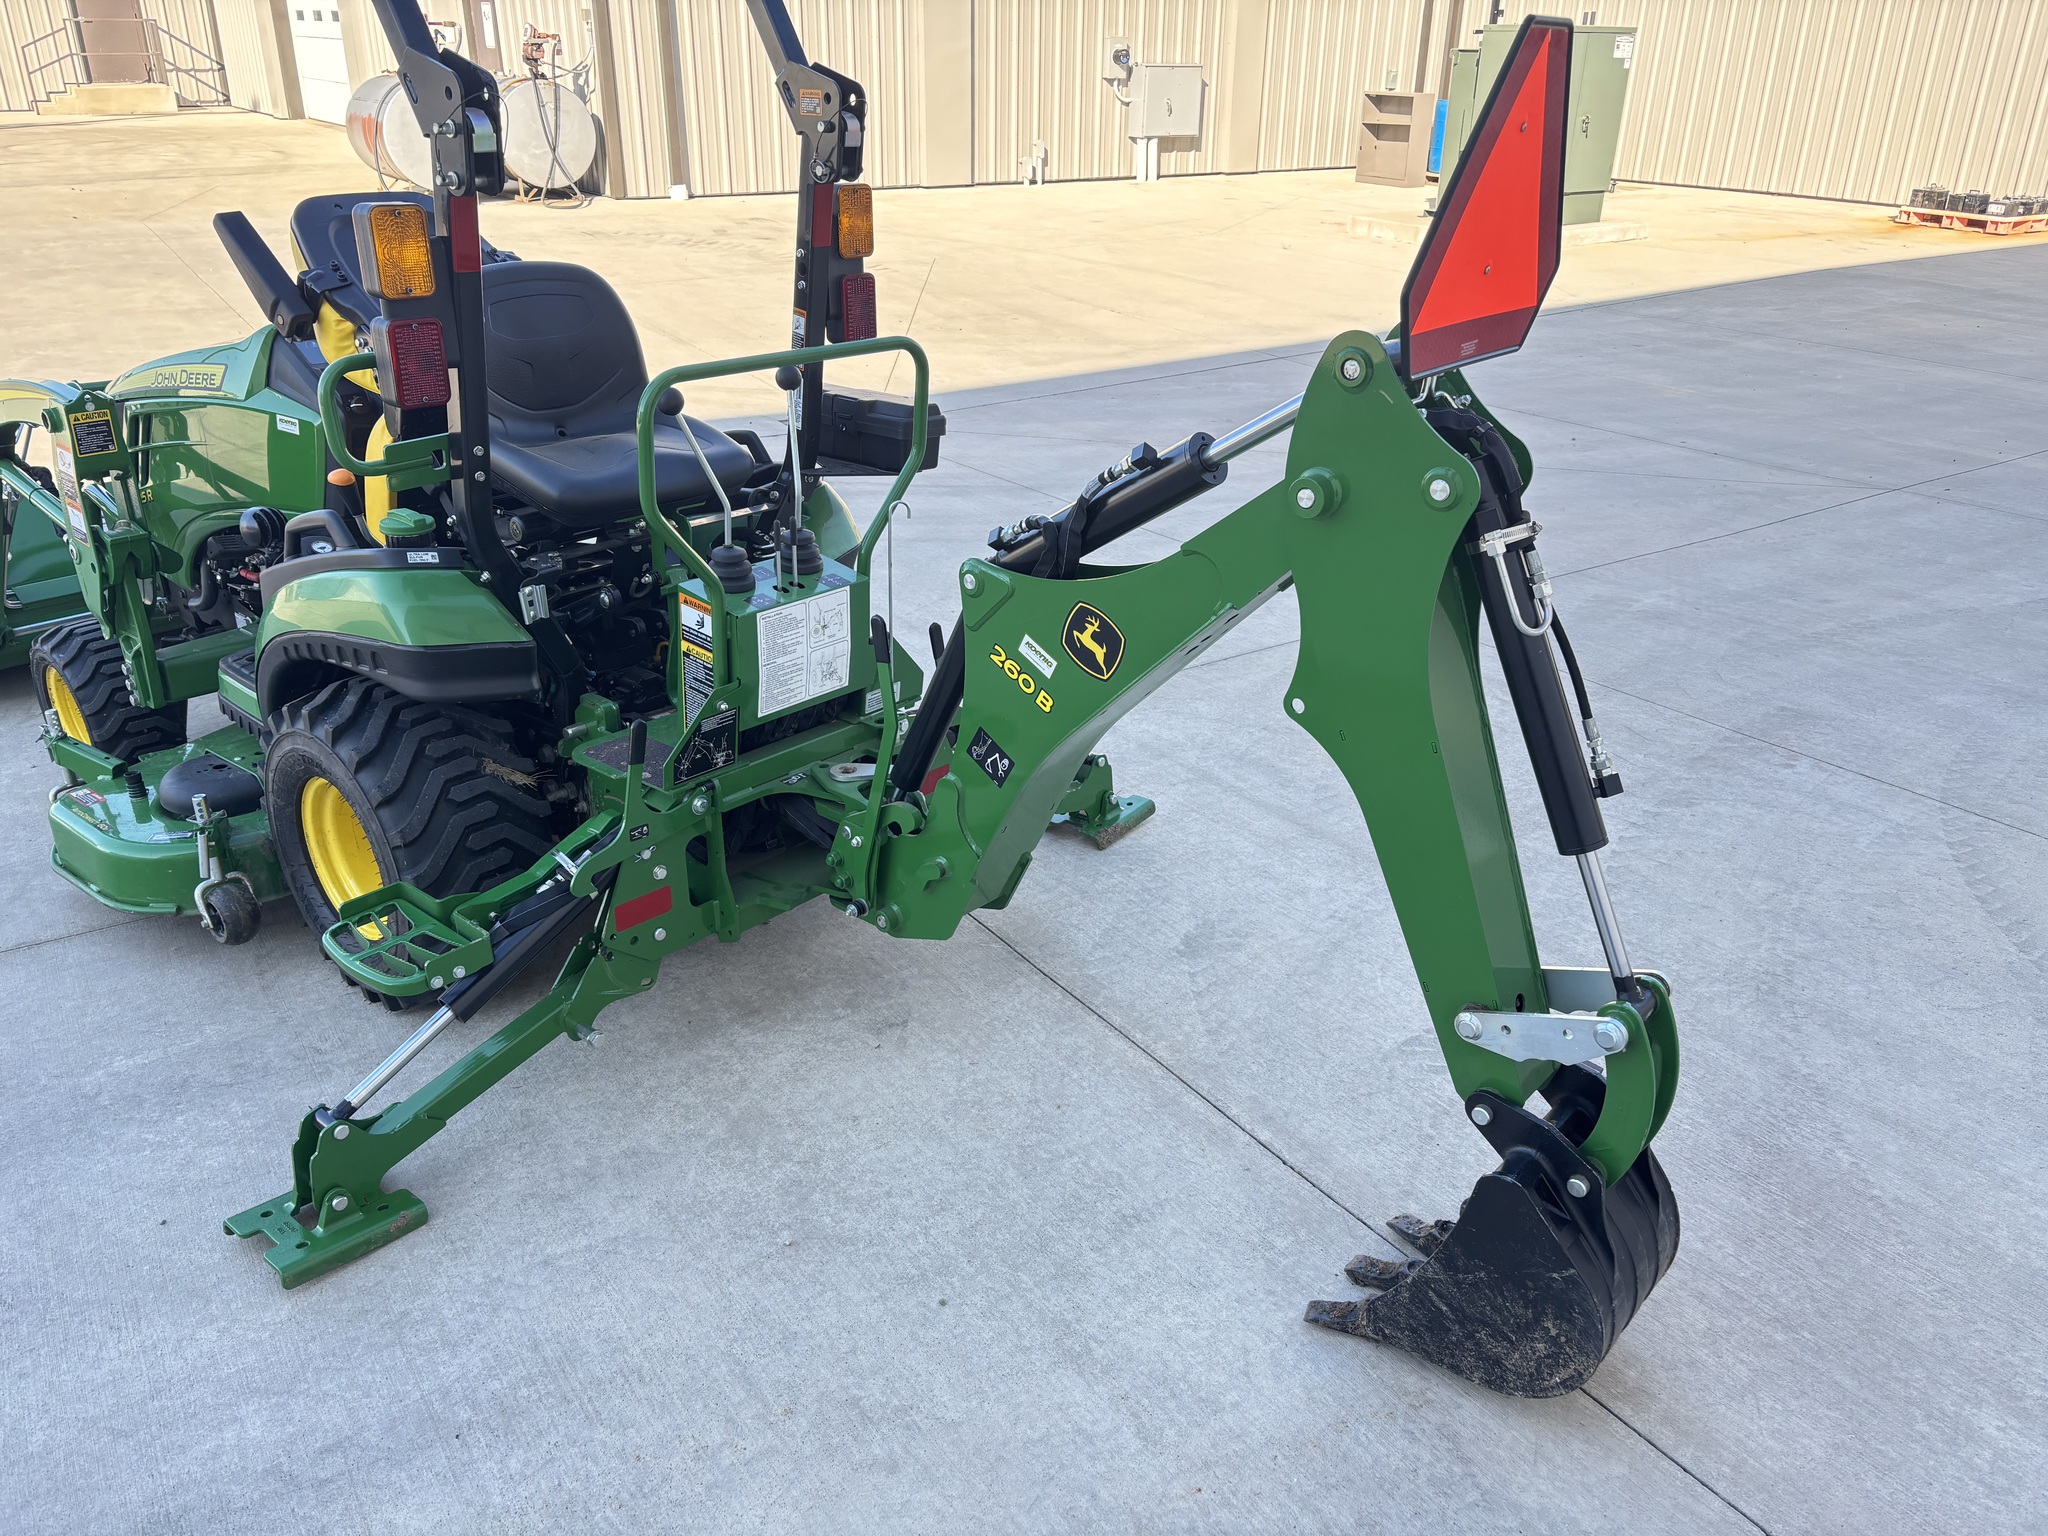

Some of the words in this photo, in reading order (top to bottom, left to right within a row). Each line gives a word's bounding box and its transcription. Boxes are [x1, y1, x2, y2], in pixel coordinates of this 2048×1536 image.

[151, 370, 178, 386] JOHN
[180, 369, 217, 387] DEERE
[80, 410, 109, 421] CAUTION
[688, 599, 711, 615] WARNIN
[691, 648, 713, 663] CAUTIO
[989, 643, 1036, 695] 260
[1034, 687, 1055, 714] B
